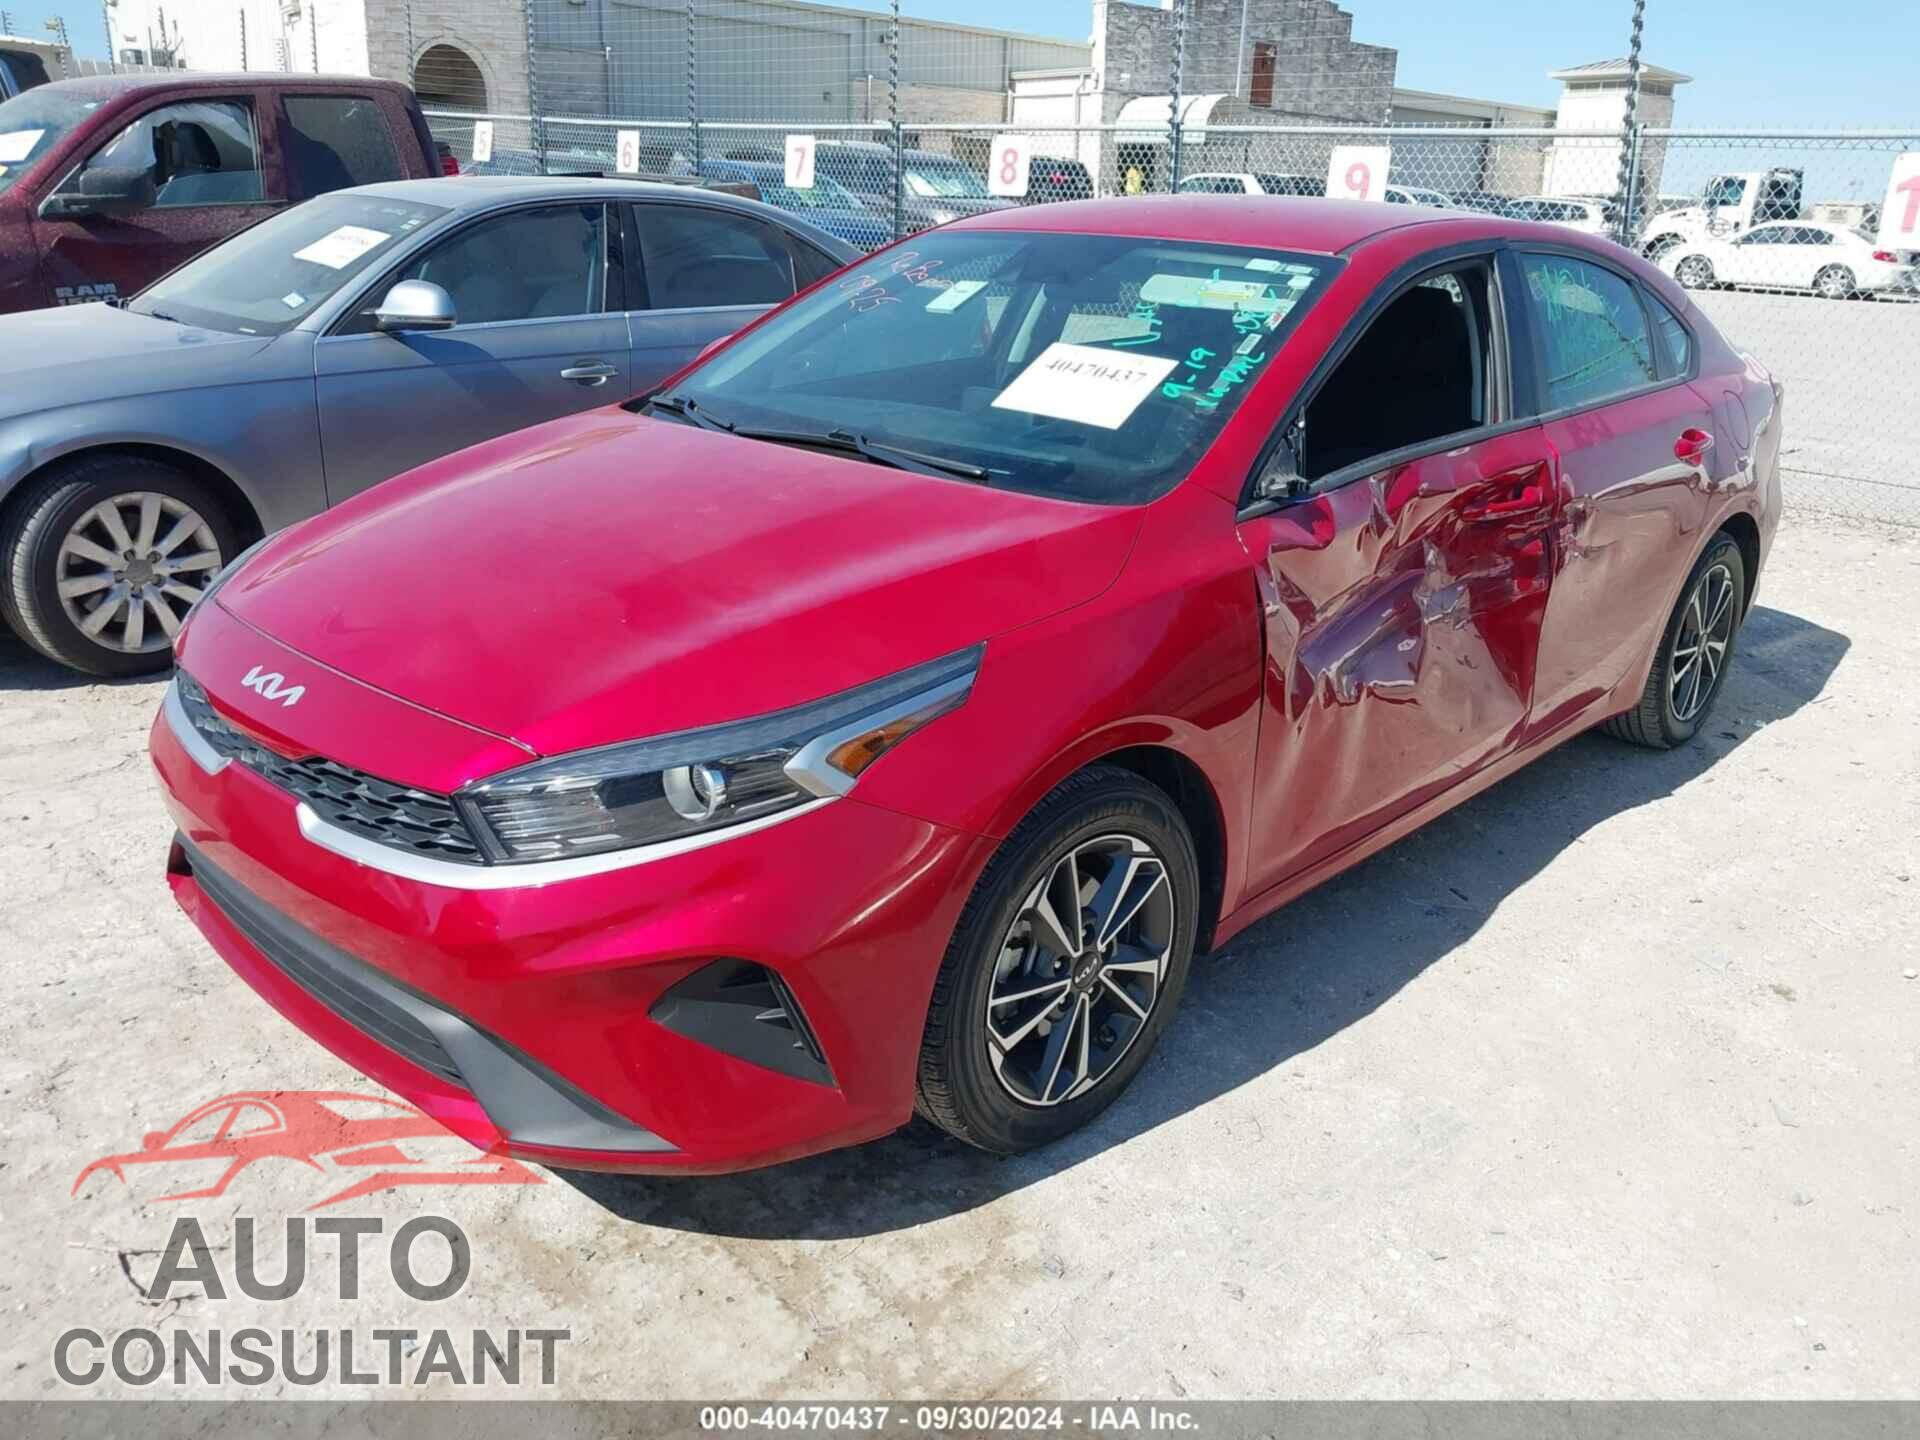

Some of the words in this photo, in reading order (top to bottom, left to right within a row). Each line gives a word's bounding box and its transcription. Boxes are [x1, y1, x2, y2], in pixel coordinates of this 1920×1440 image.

[621, 141, 633, 168] 6
[793, 147, 807, 180] 7
[1000, 147, 1019, 185] 8
[1345, 161, 1371, 201] 9
[55, 282, 118, 298] RAM
[1045, 357, 1147, 383] 40470437
[241, 664, 306, 707] KIA
